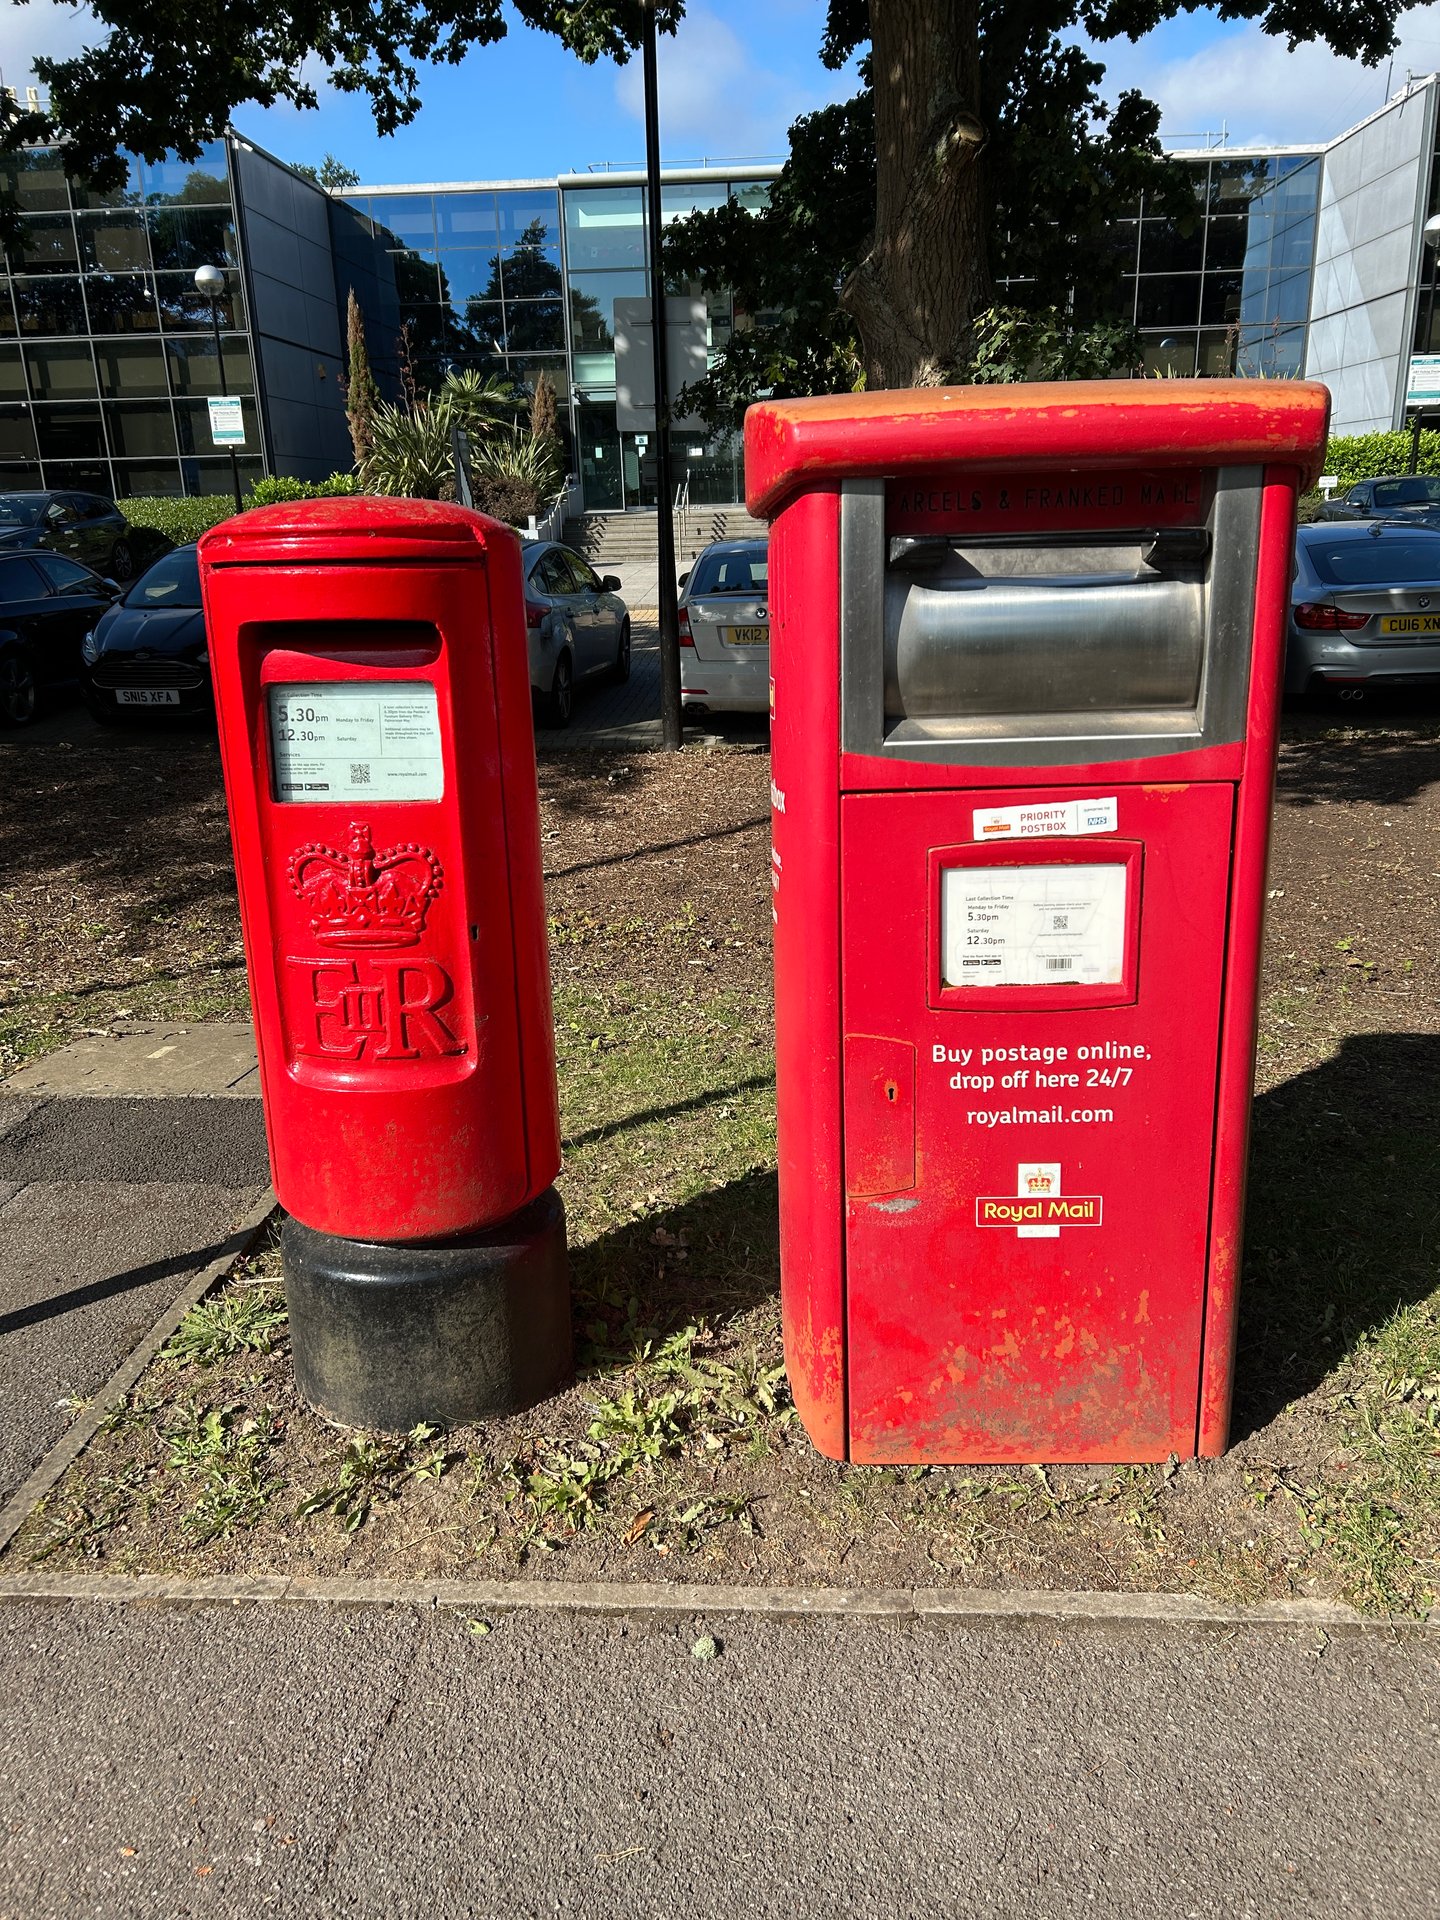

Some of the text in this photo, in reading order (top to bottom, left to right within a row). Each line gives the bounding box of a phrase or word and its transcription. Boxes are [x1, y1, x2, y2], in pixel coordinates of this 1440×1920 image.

[999, 488, 1010, 511] &
[1024, 485, 1124, 509] FRANKED
[1140, 483, 1196, 505] MAIL
[1389, 618, 1420, 632] CU16
[734, 628, 762, 641] VK12
[122, 691, 173, 702] SN15 XFA
[278, 704, 328, 723] 5.30pm
[278, 728, 326, 742] 12.30pm
[1020, 810, 1066, 822] PRIORITY
[1088, 817, 1106, 825] NHS
[1020, 822, 1067, 834] POSTBOX
[968, 912, 999, 922] 5.30pm
[967, 936, 1005, 945] 12.30pm
[932, 1041, 1152, 1066] Buy postage online,
[950, 1067, 1133, 1092] drop off here 24/7
[966, 1105, 1114, 1128] royalmail.com
[984, 1201, 1094, 1222] Royal Mail
